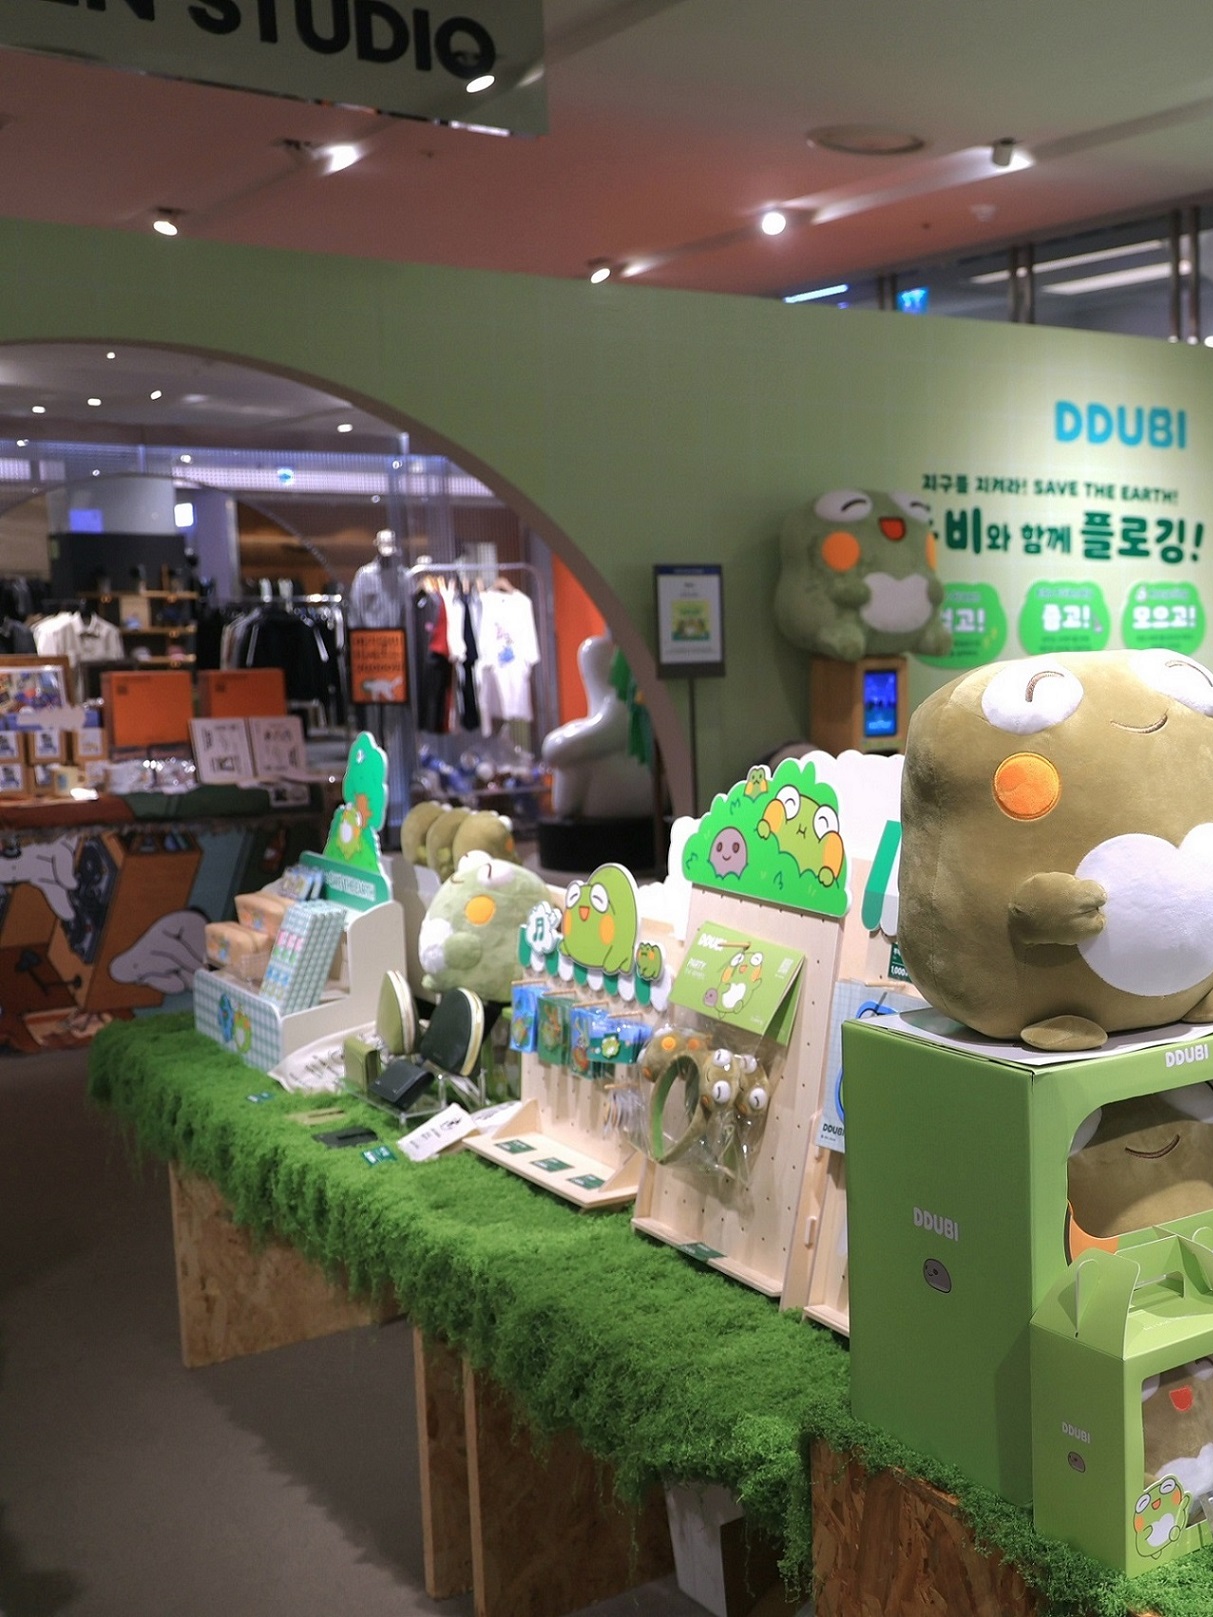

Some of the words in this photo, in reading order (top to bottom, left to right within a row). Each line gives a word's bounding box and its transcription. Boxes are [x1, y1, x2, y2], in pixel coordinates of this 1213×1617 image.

[189, 0, 496, 80] STUDIO
[1055, 400, 1187, 449] DDUBI
[1033, 479, 1079, 496] SAVE
[1083, 482, 1115, 500] THE
[1121, 486, 1179, 504] EARTH!
[930, 506, 1011, 555] 비와
[1021, 523, 1072, 555] 함께
[1081, 511, 1205, 565] 플로깅!
[1165, 1043, 1209, 1068] DDUBI
[913, 1206, 959, 1242] DDUBI
[1062, 1421, 1090, 1444] DDUBI
